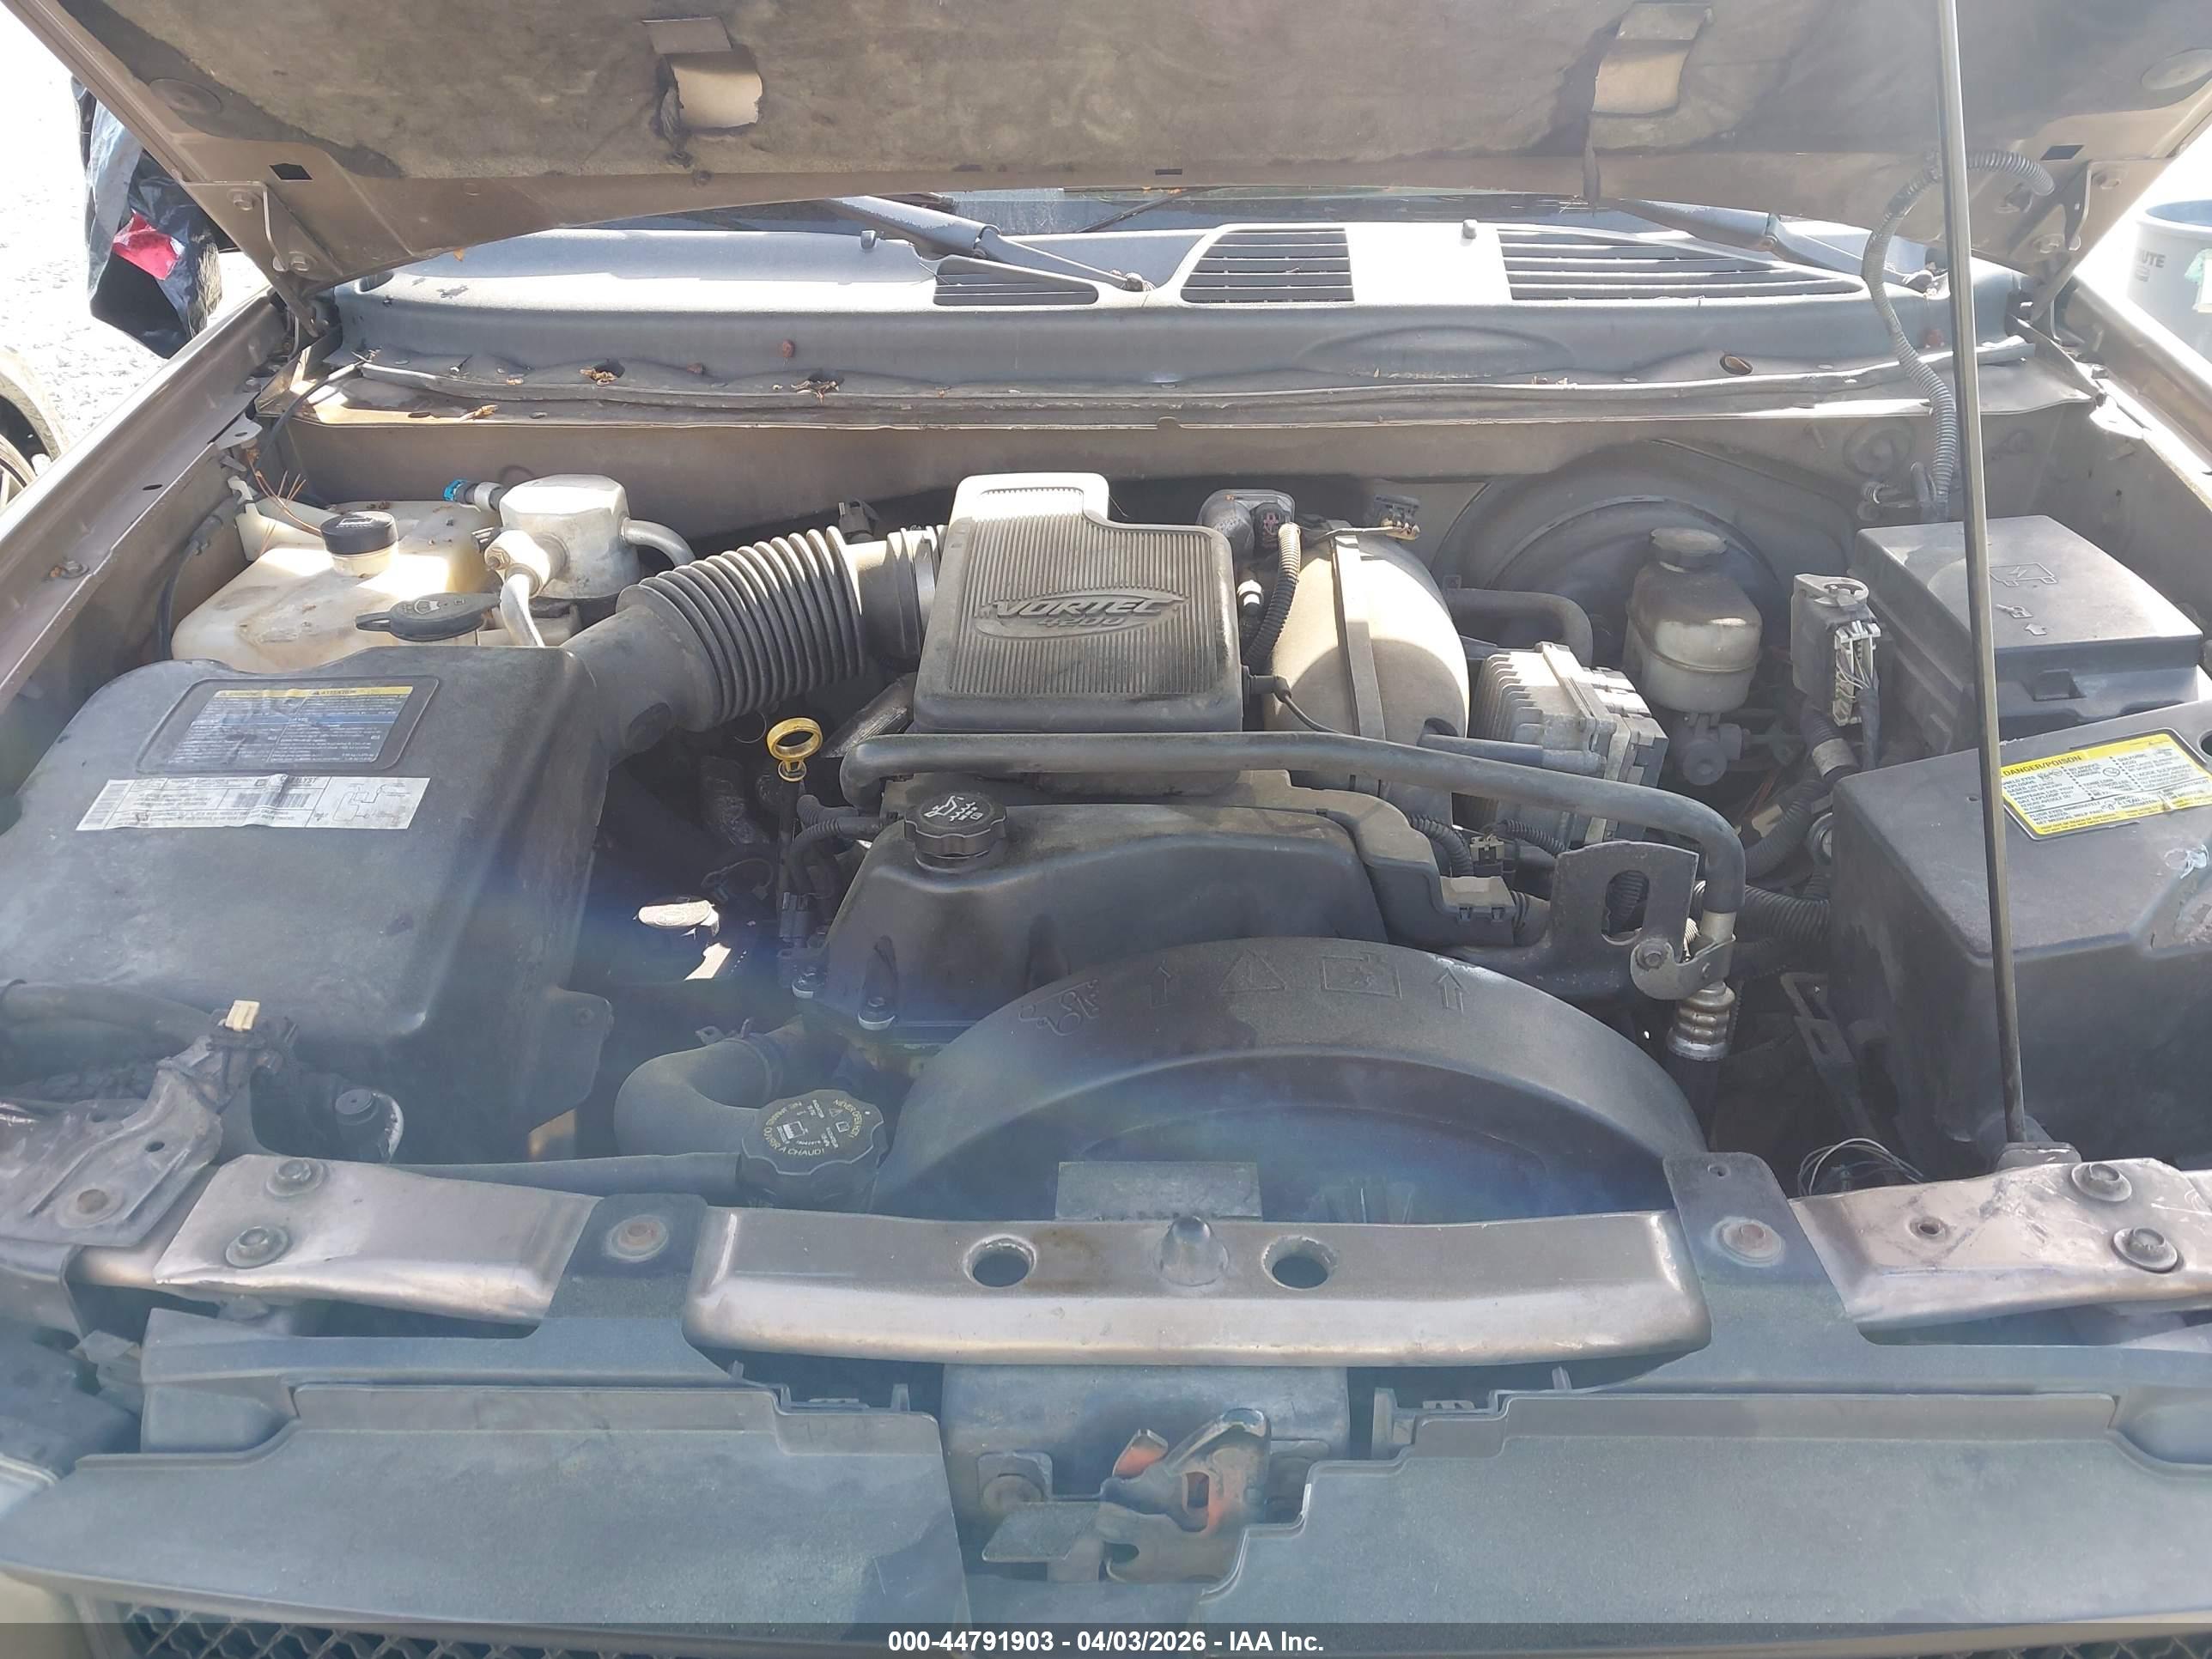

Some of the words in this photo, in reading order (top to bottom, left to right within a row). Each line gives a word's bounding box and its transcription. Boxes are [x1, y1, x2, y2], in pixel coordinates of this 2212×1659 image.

[993, 597, 1176, 617] VORTEC
[1037, 617, 1126, 628] 4200
[2002, 756, 2081, 776] DANGER/POISON
[281, 775, 317, 783] CTALYST
